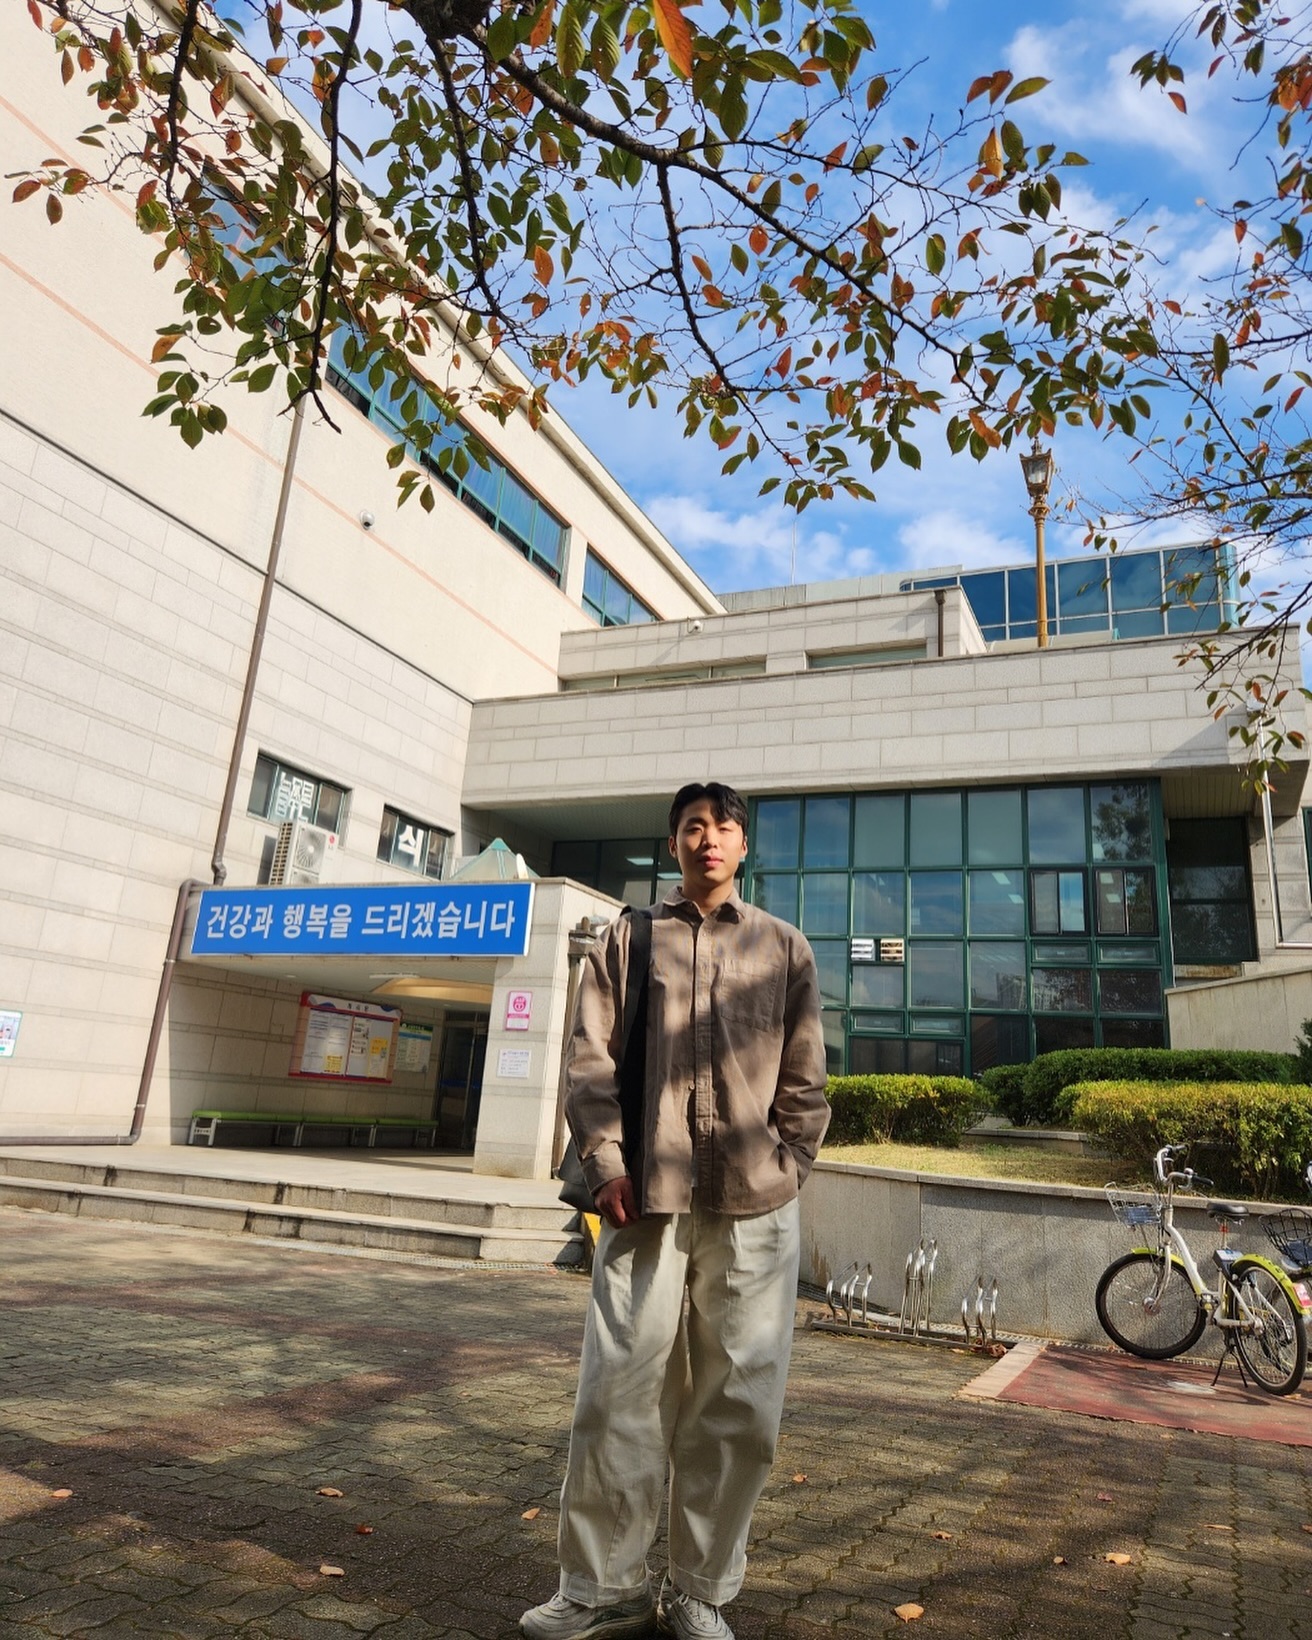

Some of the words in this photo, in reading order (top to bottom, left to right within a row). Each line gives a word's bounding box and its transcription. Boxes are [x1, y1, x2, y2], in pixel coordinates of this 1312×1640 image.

[207, 904, 274, 939] 건강과
[283, 903, 352, 939] 행복을
[361, 900, 516, 939] 드리겠습니다
